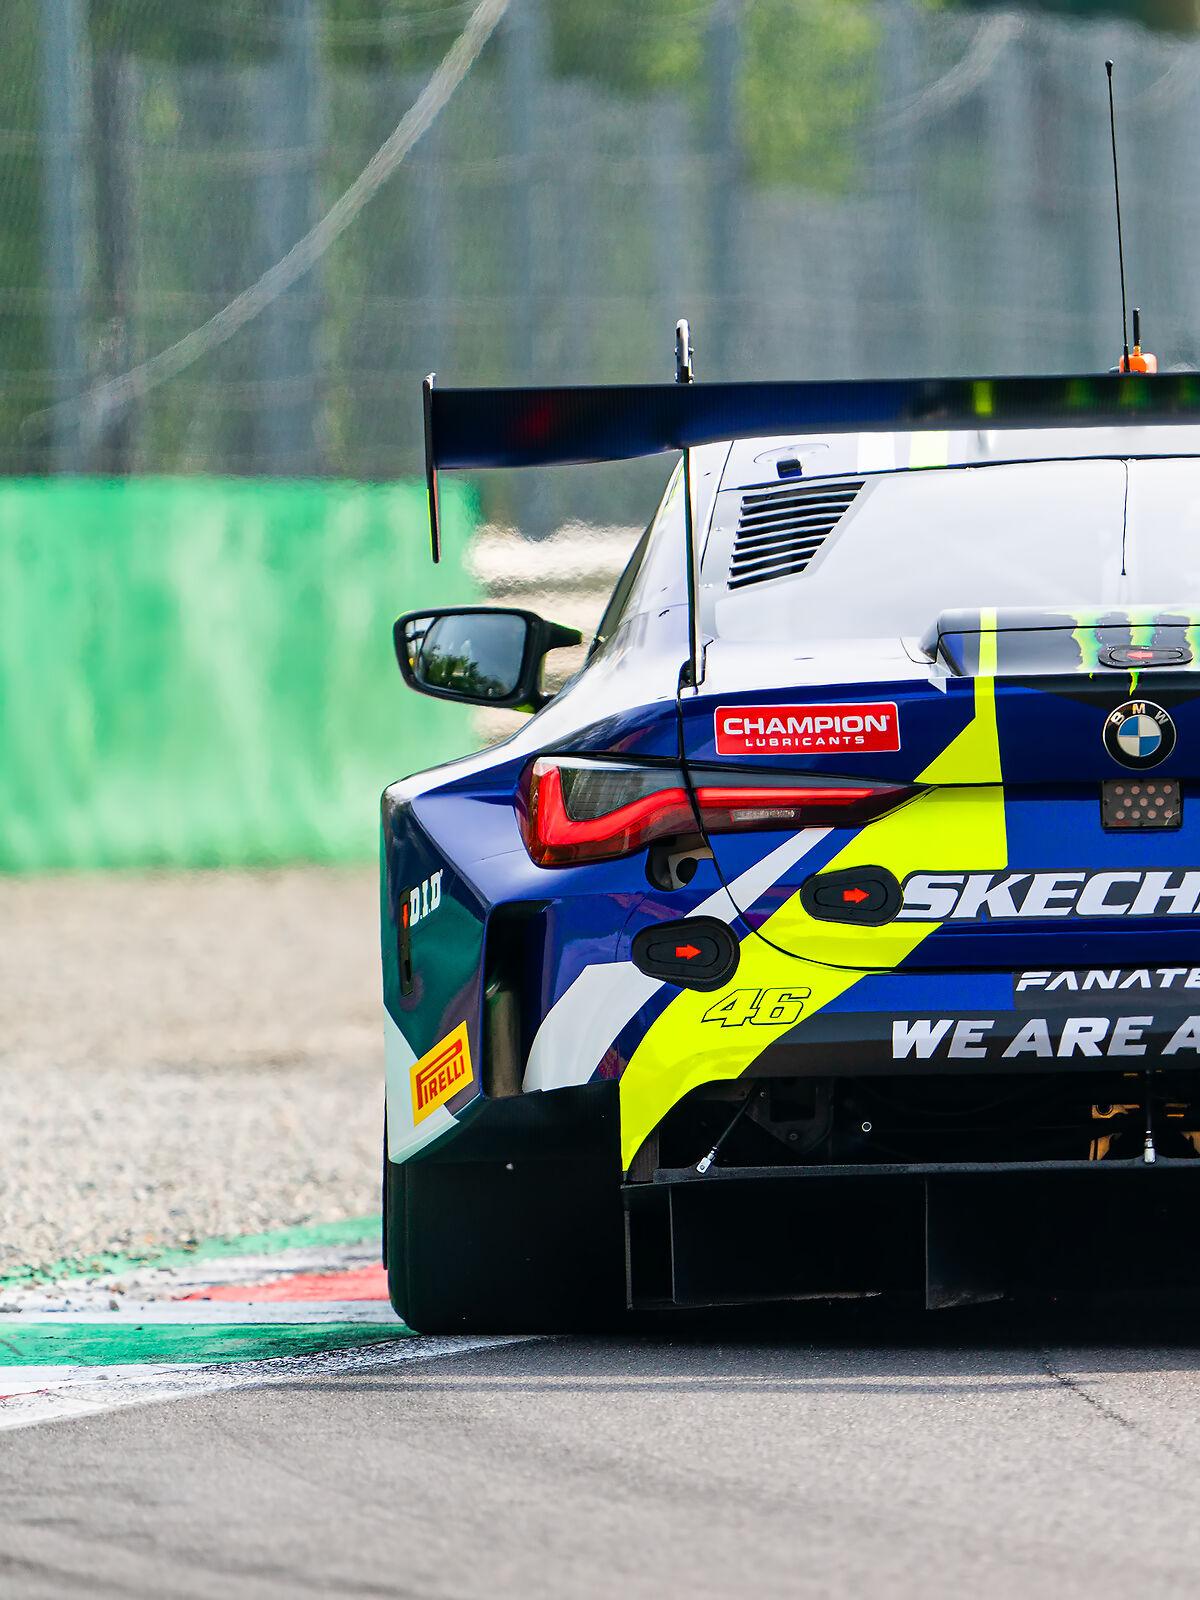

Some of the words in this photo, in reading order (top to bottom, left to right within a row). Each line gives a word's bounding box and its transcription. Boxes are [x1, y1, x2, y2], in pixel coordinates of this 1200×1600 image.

[723, 715, 887, 735] CHAMPION
[1110, 703, 1168, 726] BMW
[745, 736, 865, 747] LUBRICANTS
[701, 986, 811, 1028] 46
[892, 1019, 995, 1059] WE
[1001, 1016, 1154, 1058] ARE
[416, 1038, 465, 1111] PIRELLI
